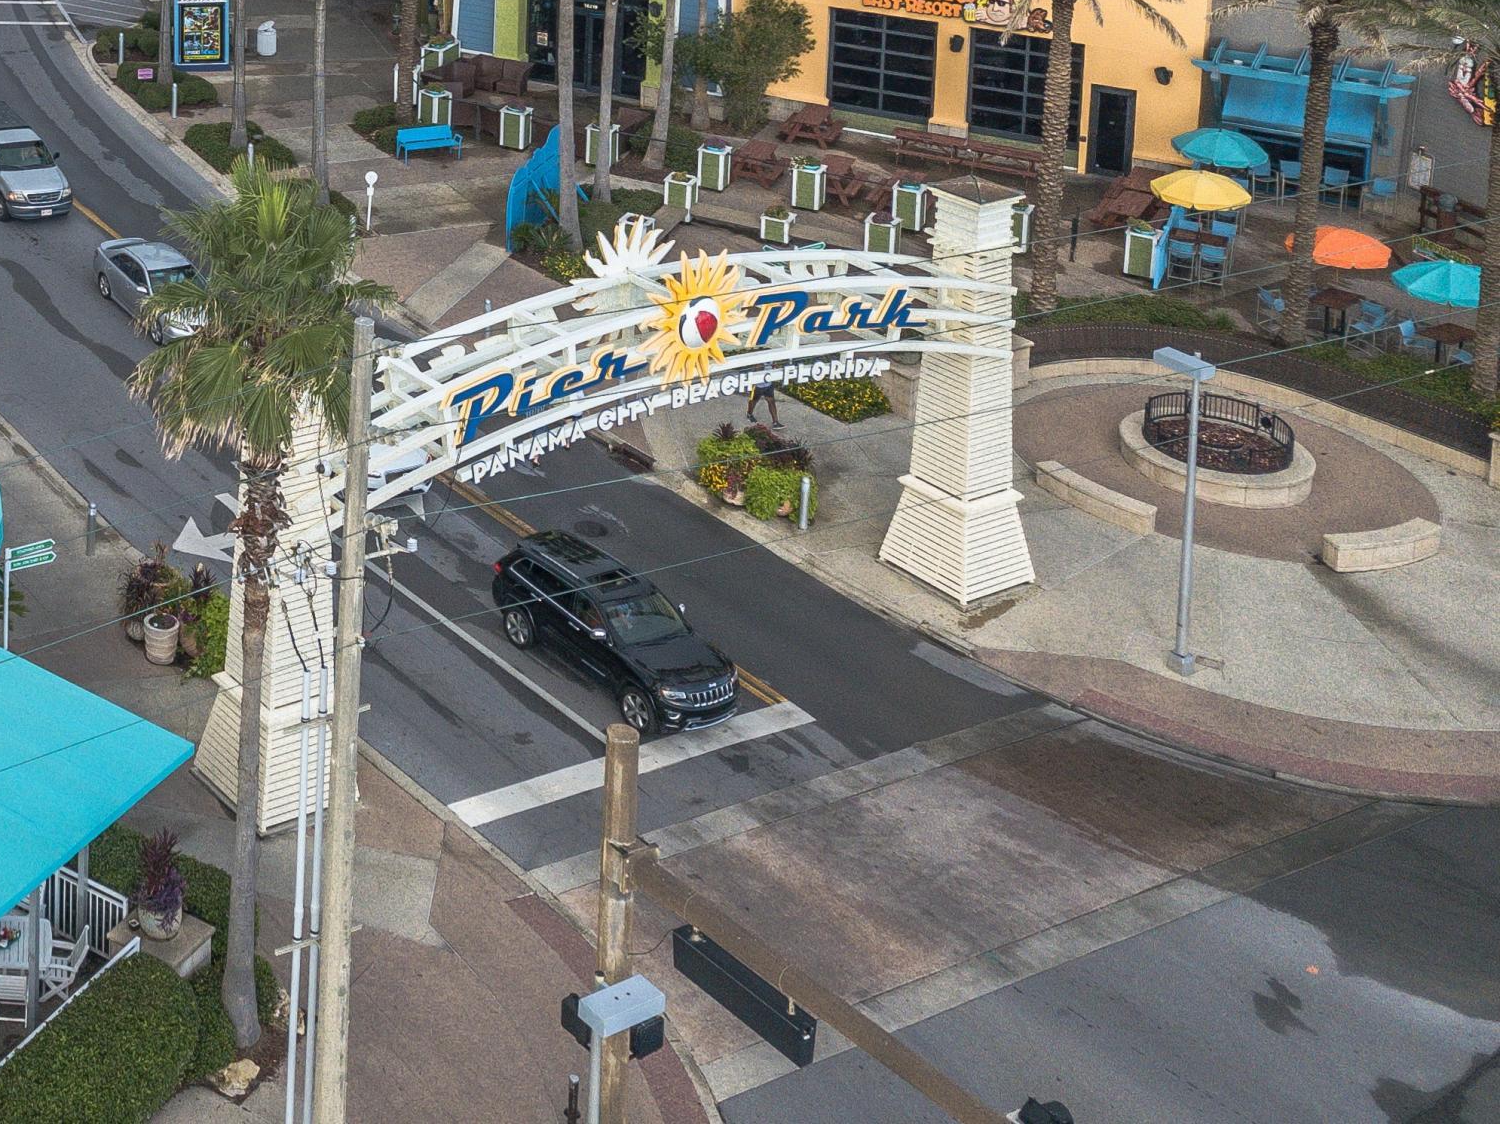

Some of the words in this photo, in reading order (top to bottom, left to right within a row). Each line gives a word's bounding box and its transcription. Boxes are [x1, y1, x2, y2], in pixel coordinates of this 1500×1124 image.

[440, 343, 650, 447] Pier
[745, 284, 927, 347] Park
[470, 420, 587, 485] PANAMA
[597, 394, 660, 432] CITY
[671, 371, 753, 409] BEACH
[783, 357, 883, 386] FLORIDA
